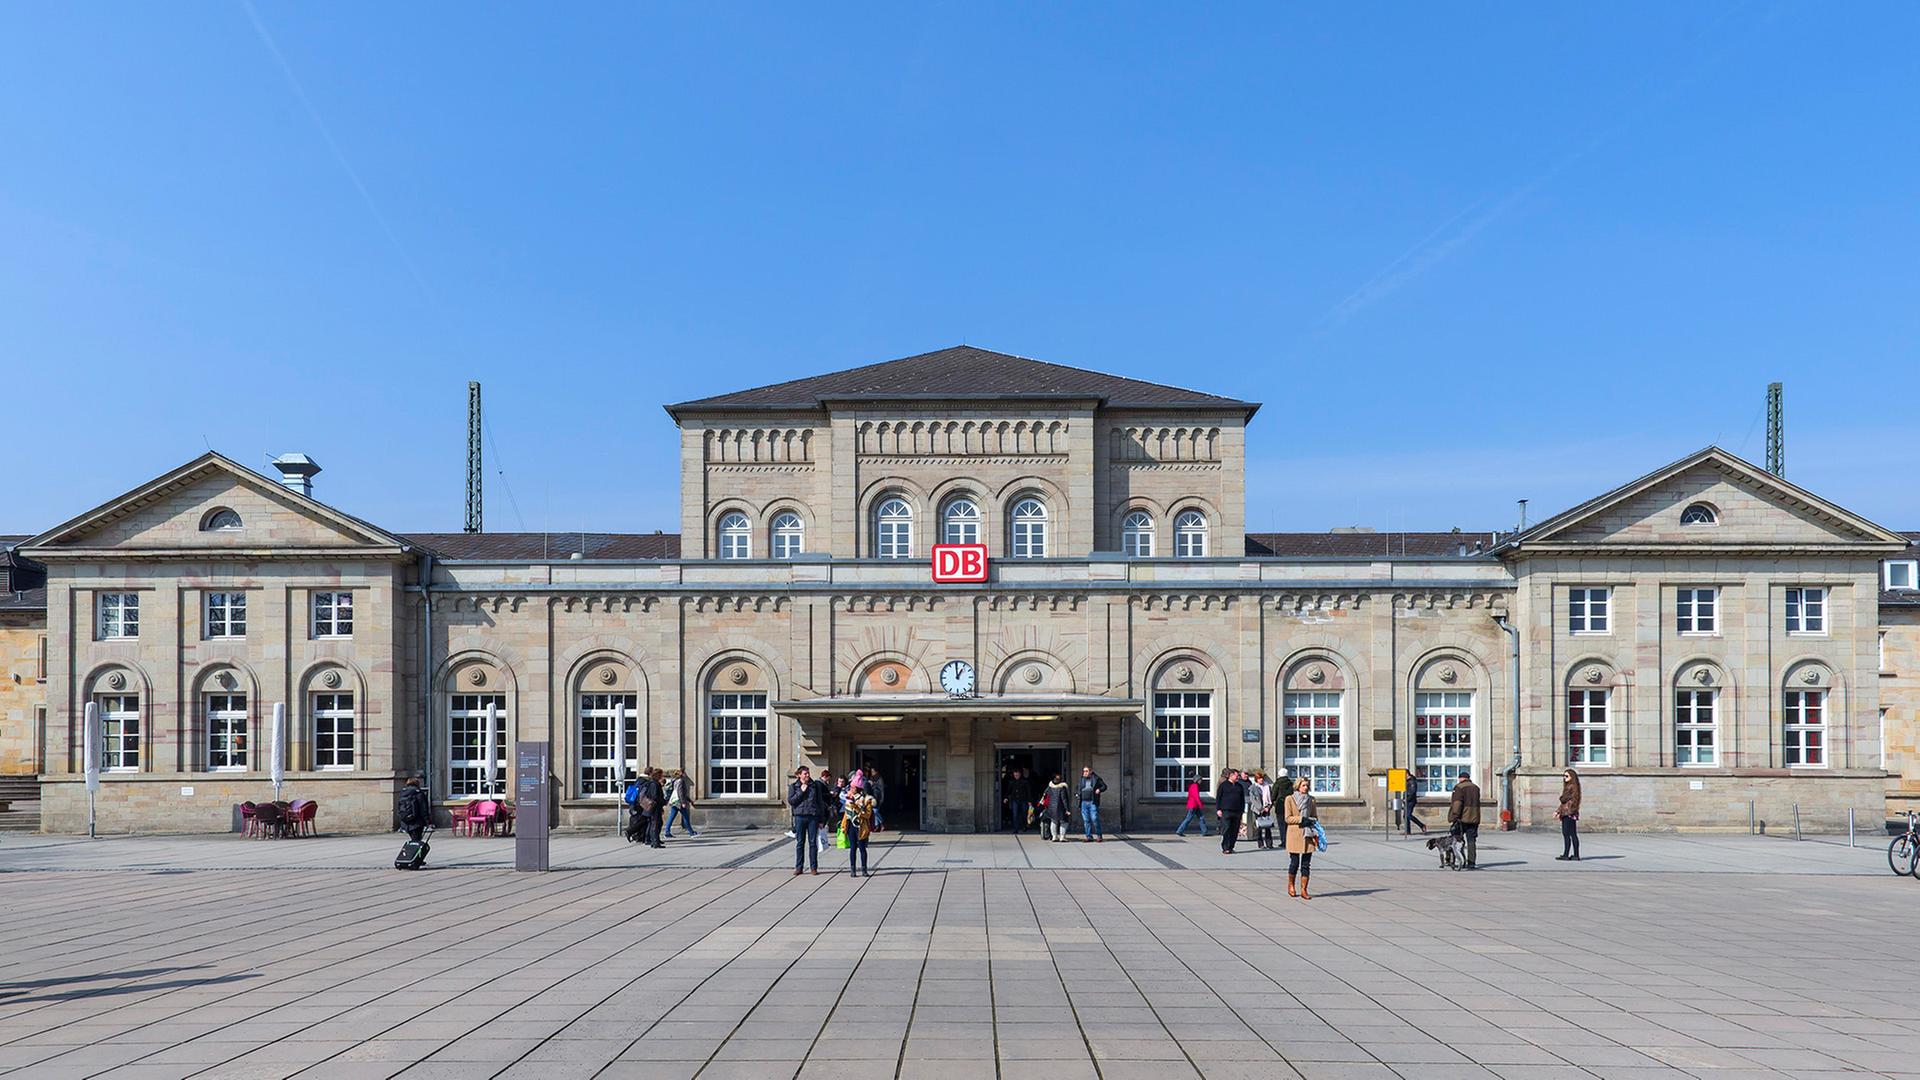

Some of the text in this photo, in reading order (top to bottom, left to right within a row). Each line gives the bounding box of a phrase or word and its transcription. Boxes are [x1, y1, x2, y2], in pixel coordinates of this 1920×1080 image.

[940, 551, 981, 575] DB
[1287, 717, 1337, 727] PRESSE
[1417, 717, 1468, 726] BUCH
